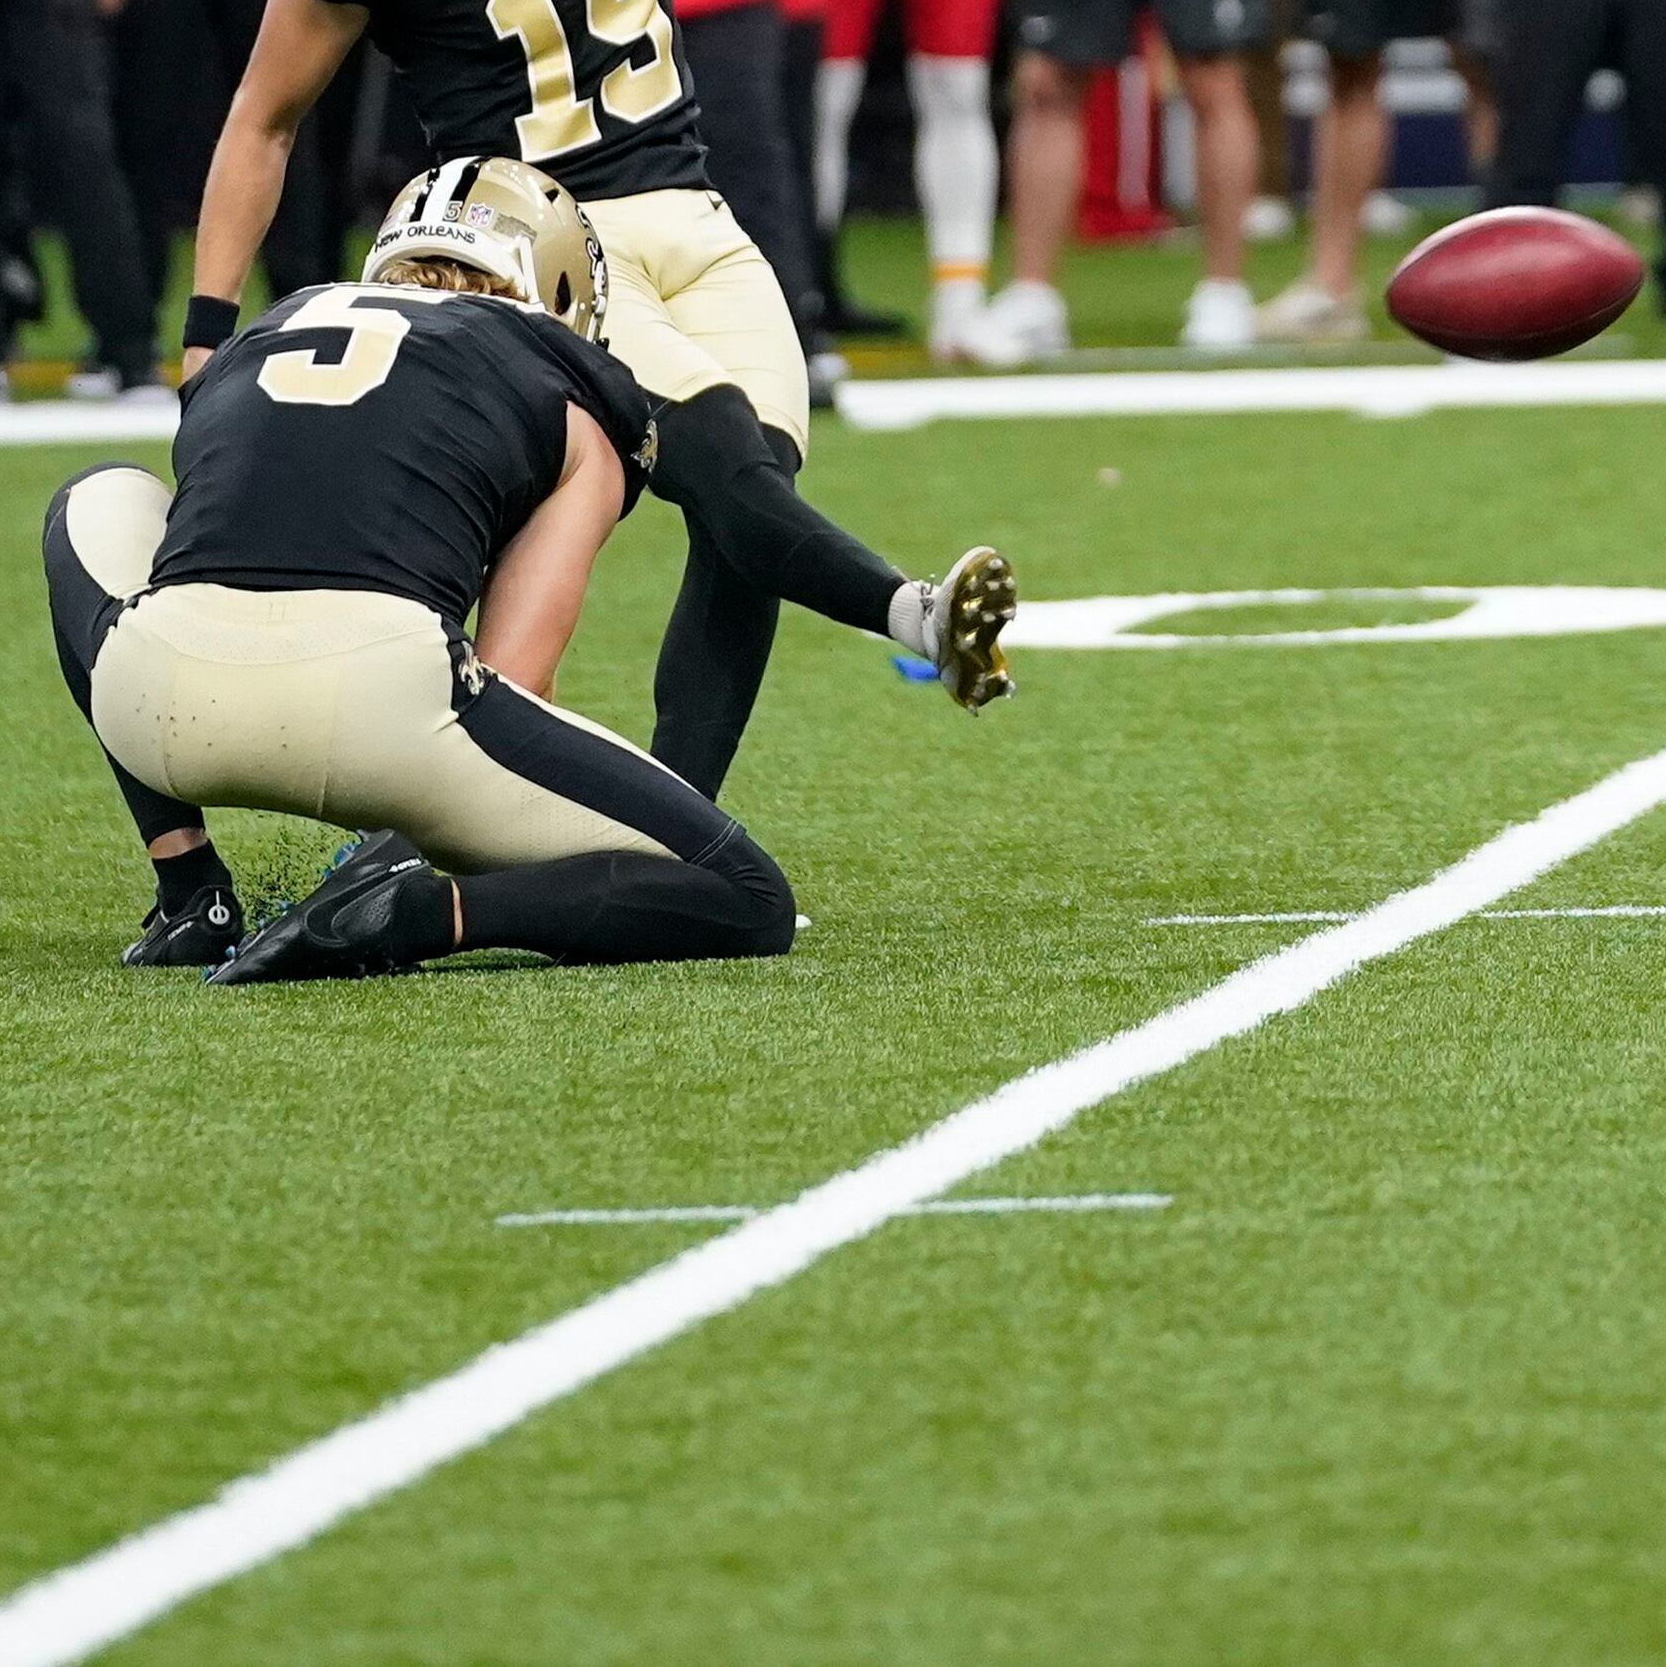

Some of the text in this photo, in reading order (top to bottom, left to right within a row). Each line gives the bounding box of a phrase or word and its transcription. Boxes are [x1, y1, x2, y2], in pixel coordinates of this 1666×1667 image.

[445, 200, 464, 221] 5
[374, 225, 475, 253] NEW ORLEANS
[256, 285, 413, 406] 5
